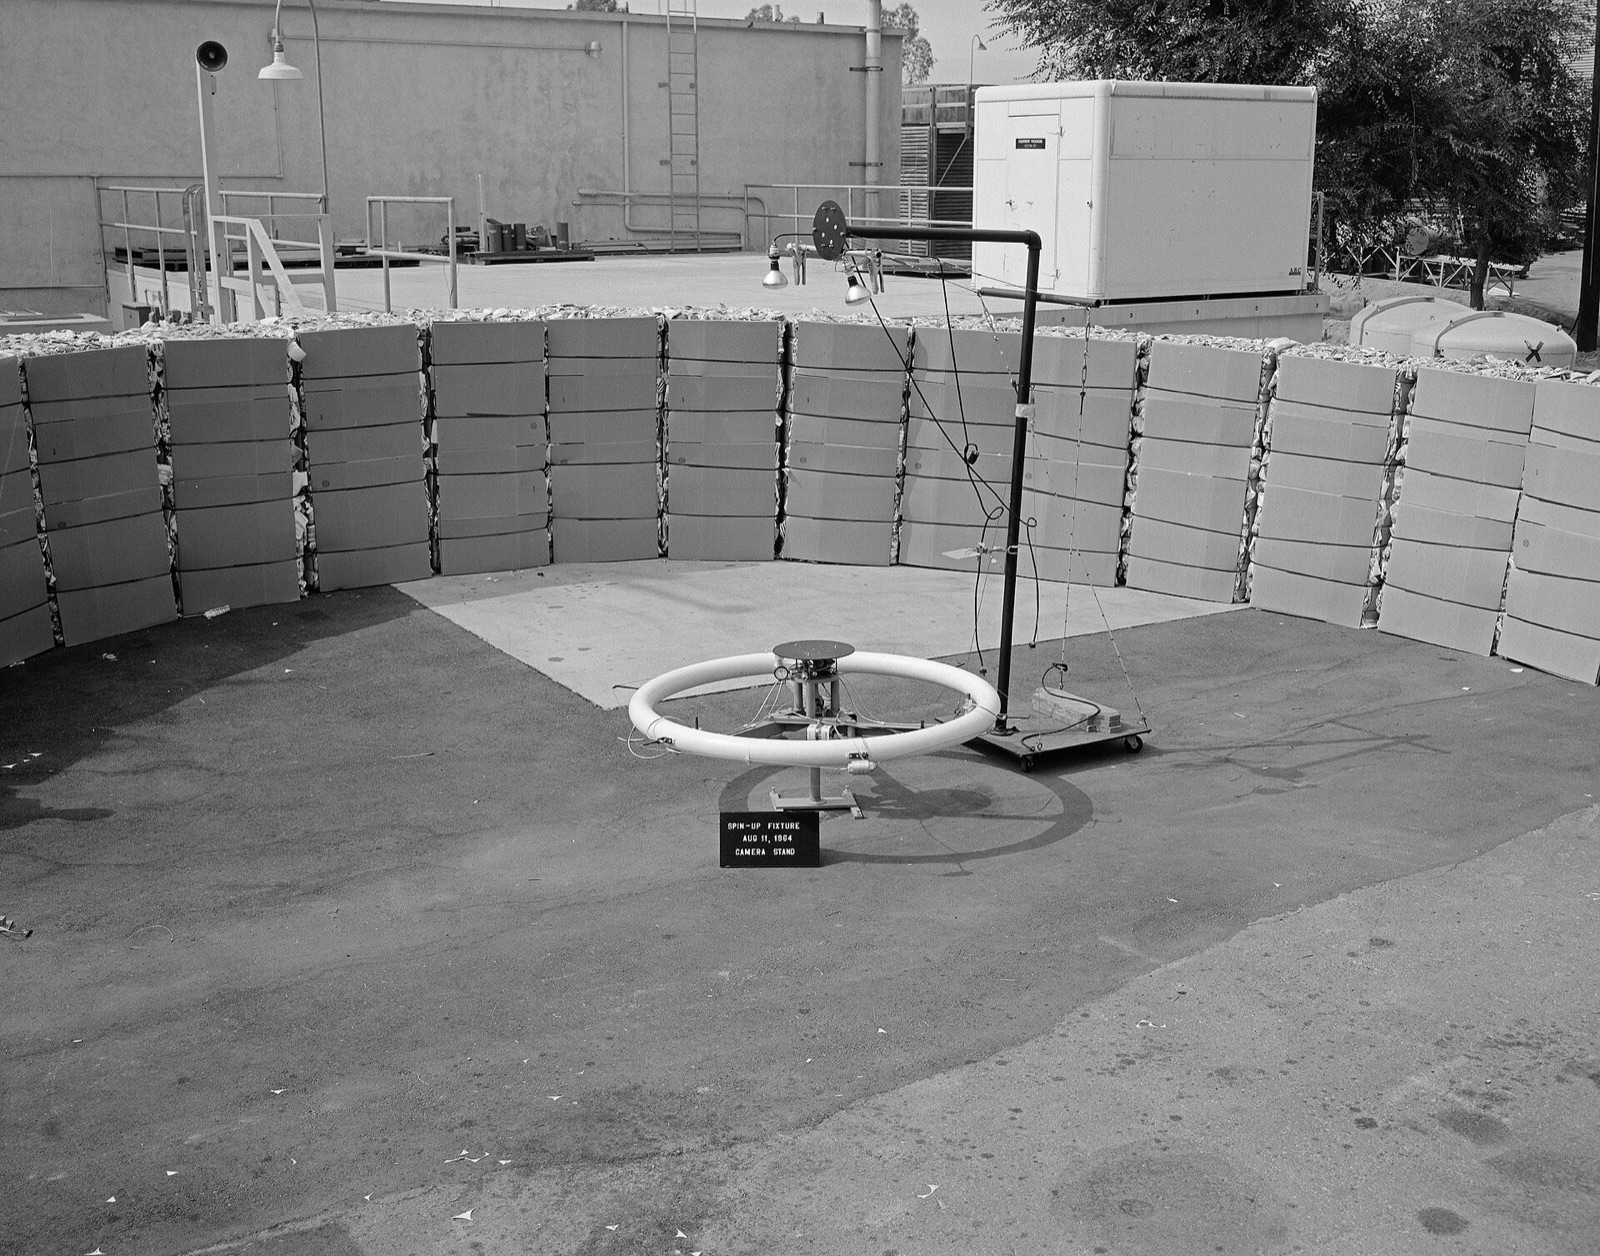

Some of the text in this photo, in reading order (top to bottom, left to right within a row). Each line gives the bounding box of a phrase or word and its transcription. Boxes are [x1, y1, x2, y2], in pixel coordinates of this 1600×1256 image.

[727, 822, 800, 830] SPIN-UP FIXTURE
[742, 834, 793, 844] AUG 11, 1964
[735, 848, 795, 856] CAMERA STAND
